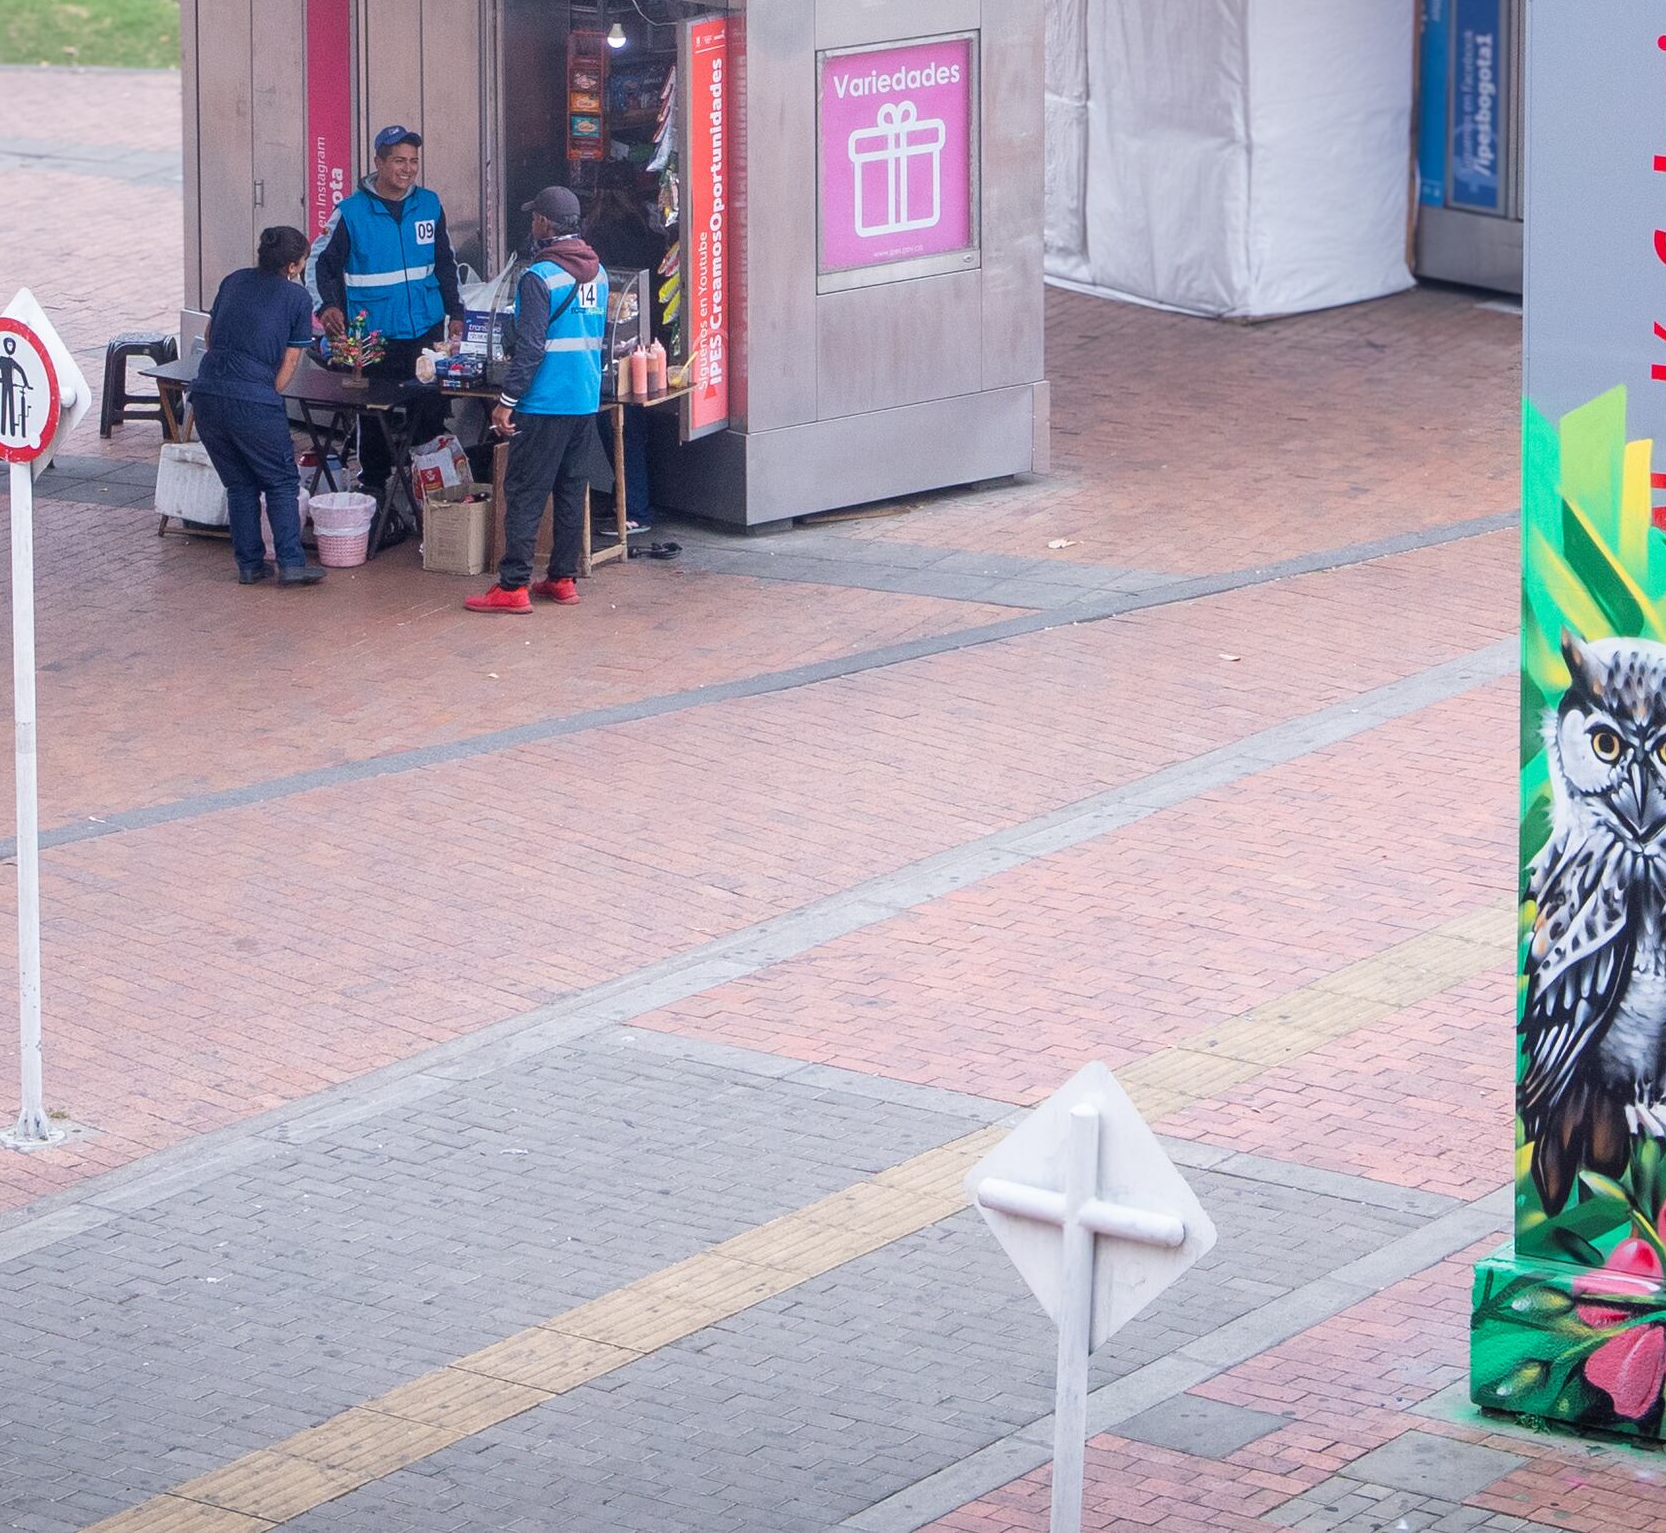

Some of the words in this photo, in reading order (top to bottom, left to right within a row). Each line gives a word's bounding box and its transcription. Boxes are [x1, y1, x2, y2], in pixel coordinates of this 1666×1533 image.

[833, 61, 960, 99] Variedades
[315, 136, 327, 207] Instagram
[709, 58, 725, 330] CreamosOportunidades
[417, 222, 434, 240] 09
[698, 232, 708, 297] Youtube
[580, 283, 596, 306] 14
[700, 298, 708, 317] en
[709, 334, 723, 386] IPES
